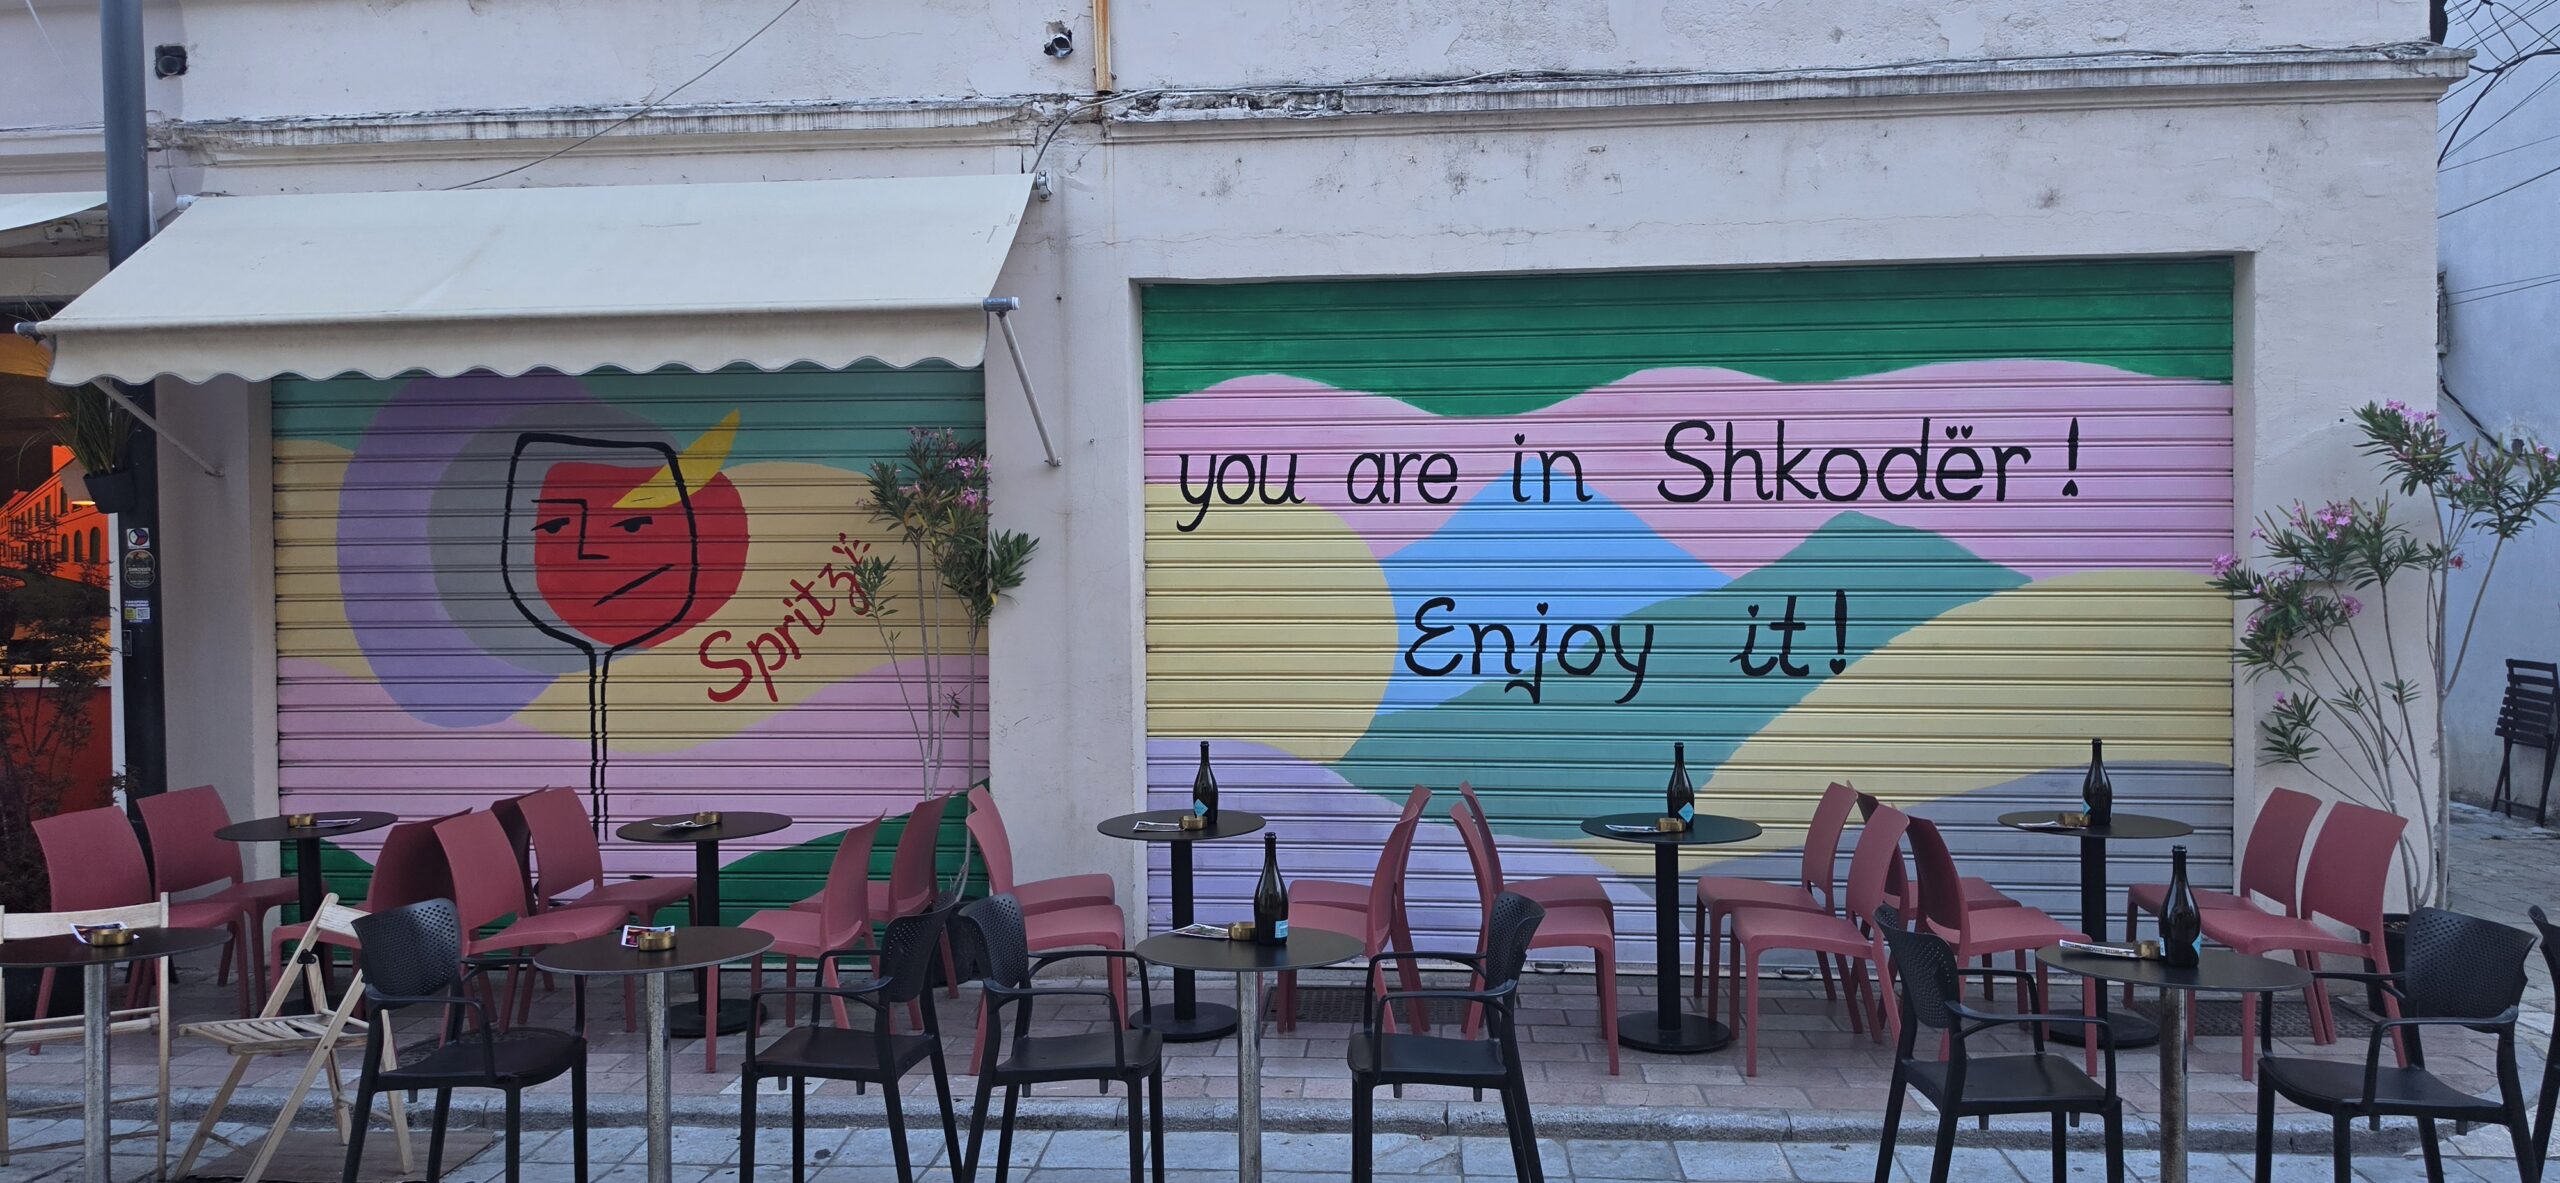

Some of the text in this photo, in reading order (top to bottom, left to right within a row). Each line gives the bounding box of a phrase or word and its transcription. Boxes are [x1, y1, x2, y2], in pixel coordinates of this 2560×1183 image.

[1176, 453, 1306, 533] you
[1346, 453, 1460, 505] are
[1512, 433, 1594, 504] in
[1404, 590, 1850, 704] Enjoy it!
